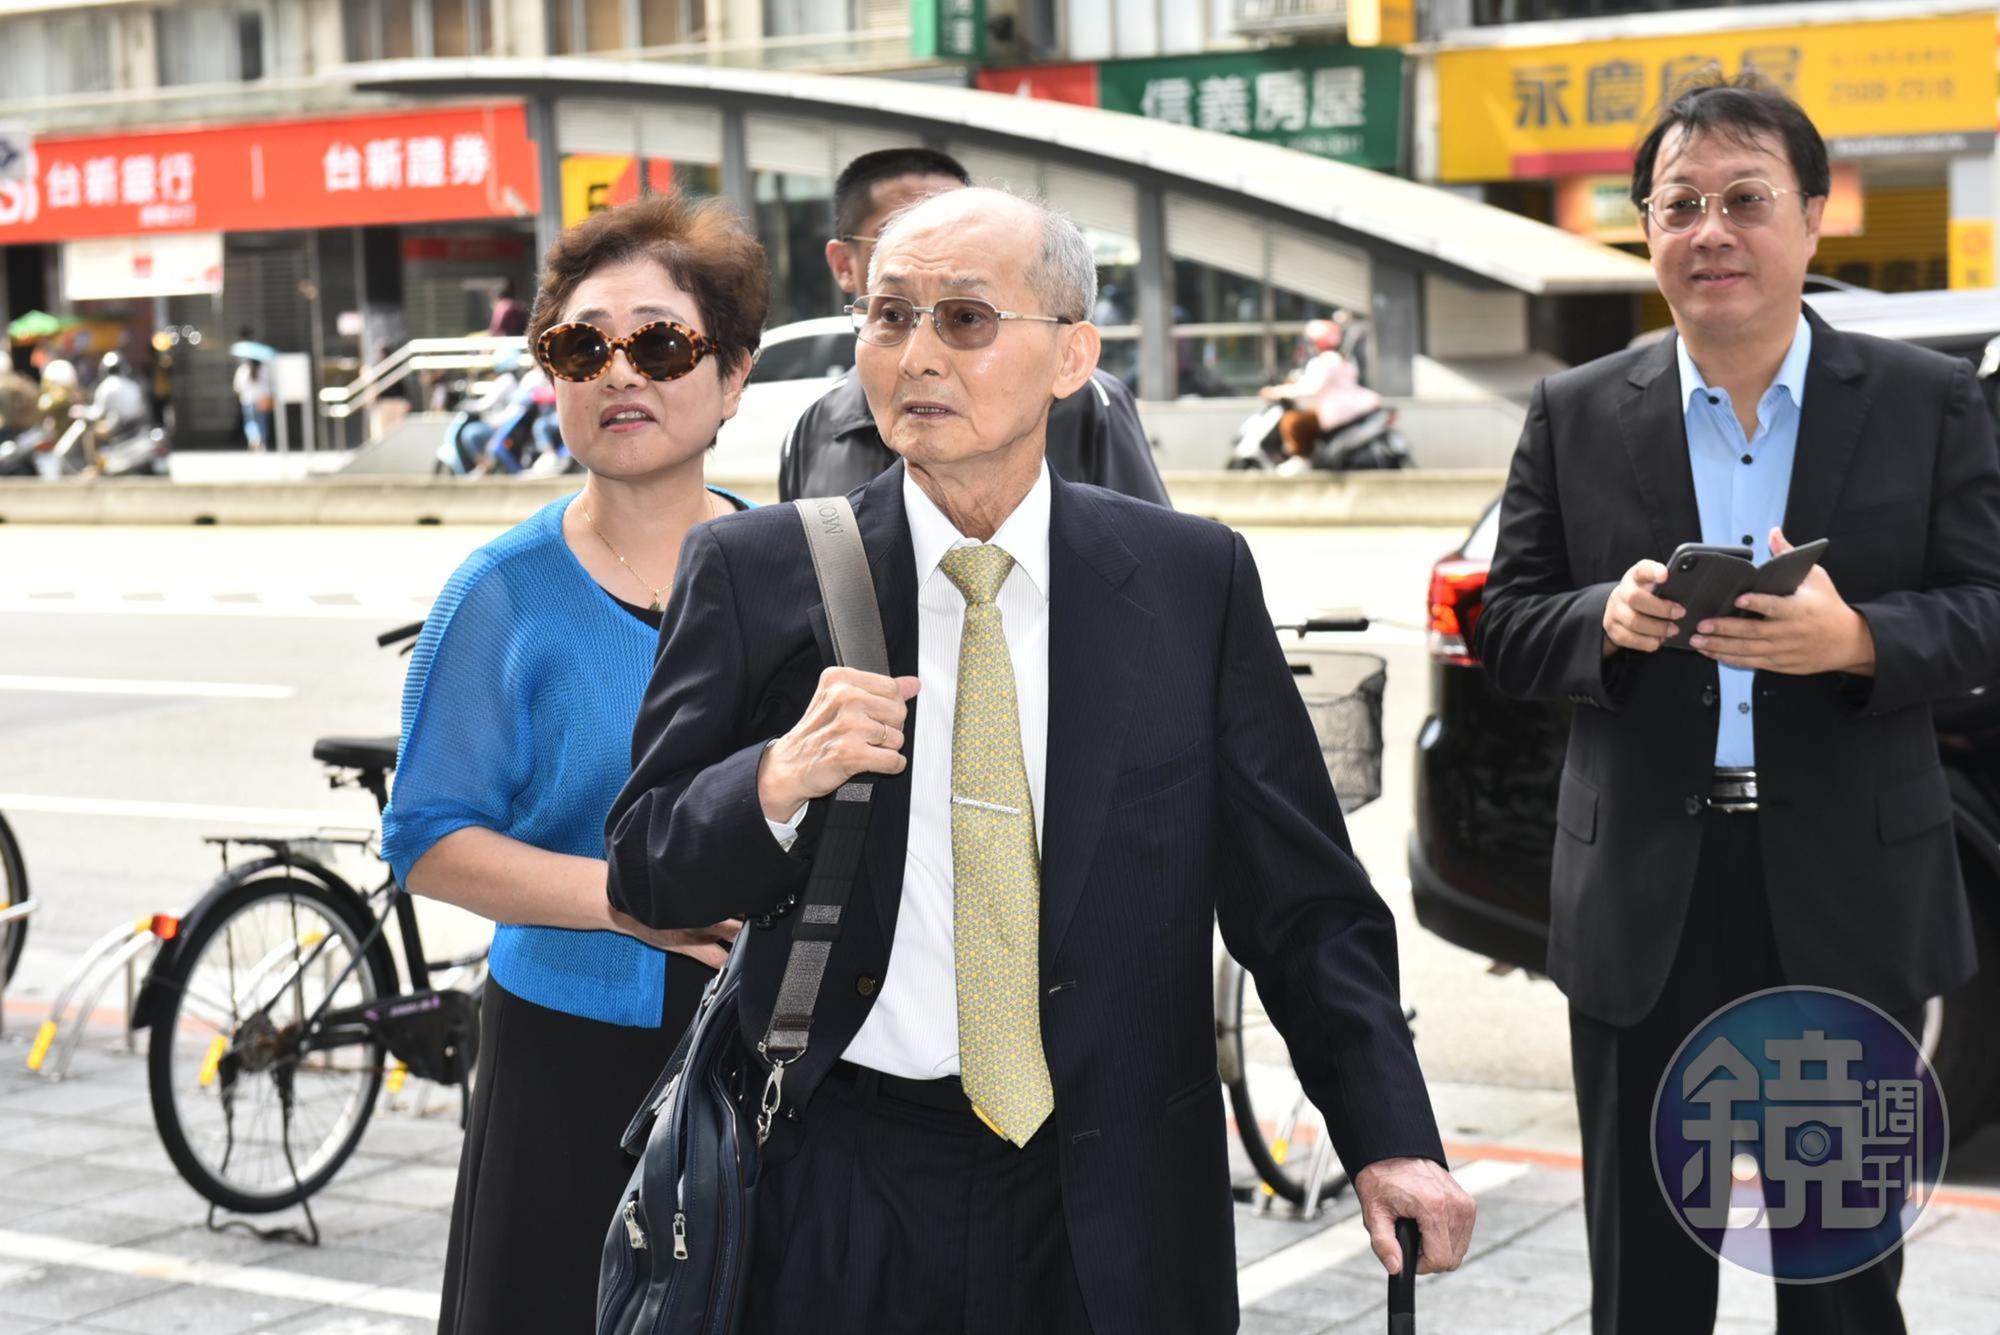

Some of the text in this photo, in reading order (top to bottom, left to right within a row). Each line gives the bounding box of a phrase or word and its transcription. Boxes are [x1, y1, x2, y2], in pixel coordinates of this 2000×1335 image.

[1141, 66, 1367, 133] 信義房屋
[47, 153, 195, 209] 台新銀行
[323, 132, 490, 192] 台新證券
